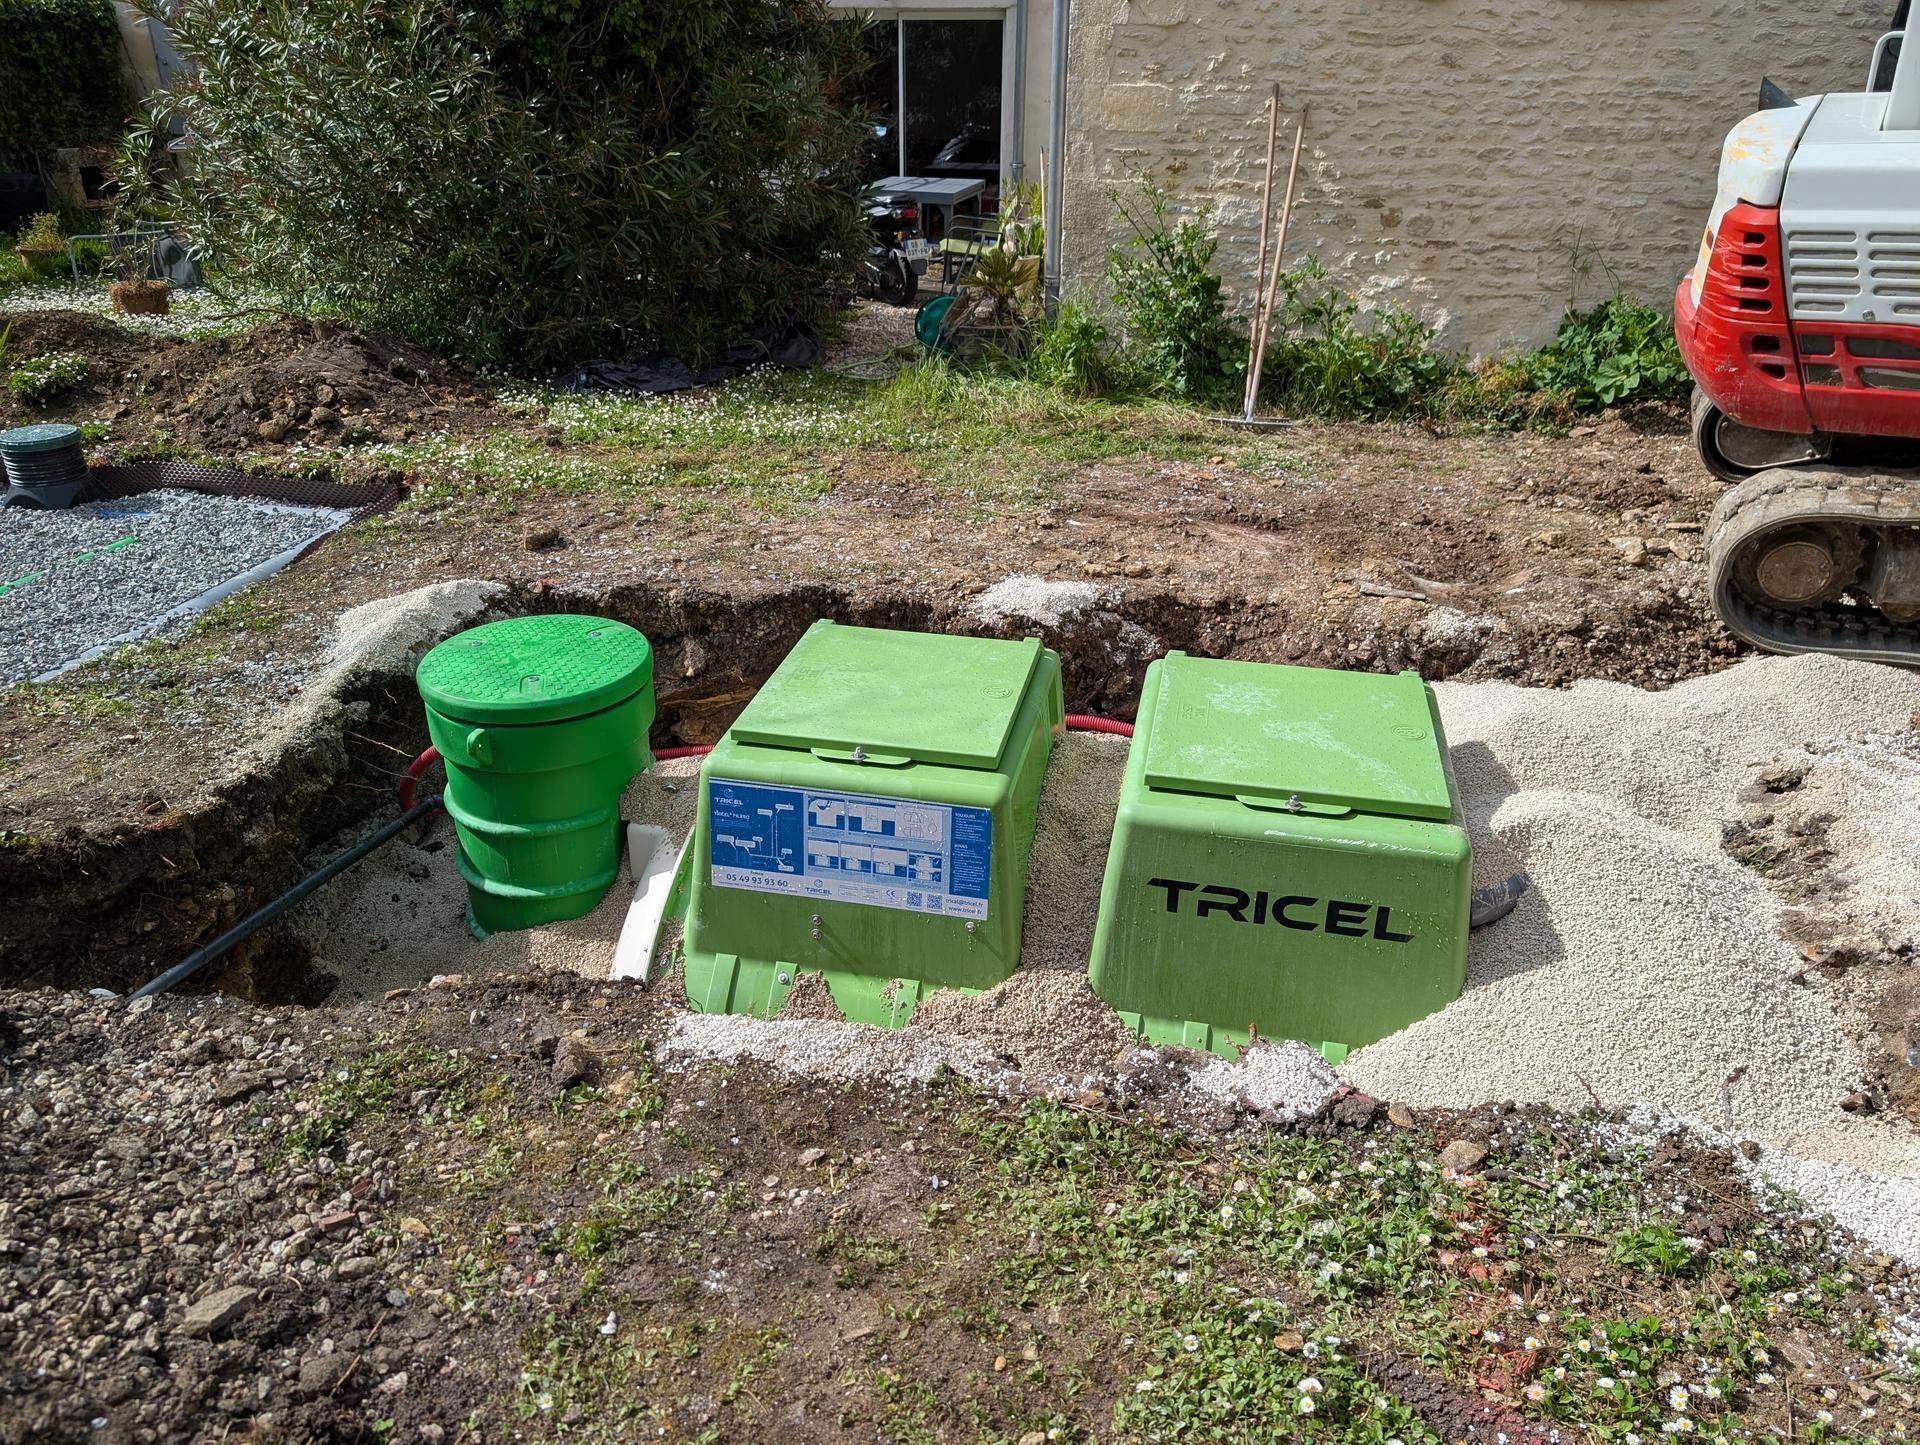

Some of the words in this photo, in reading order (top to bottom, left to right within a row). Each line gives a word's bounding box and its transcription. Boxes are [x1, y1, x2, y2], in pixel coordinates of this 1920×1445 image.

[714, 797, 744, 806] TRICEL
[726, 873, 737, 881] 05
[751, 876, 762, 884] 93
[764, 878, 775, 886] 93
[777, 879, 788, 887] 60
[805, 887, 833, 895] TRICEL
[1147, 877, 1416, 943] TRICEL
